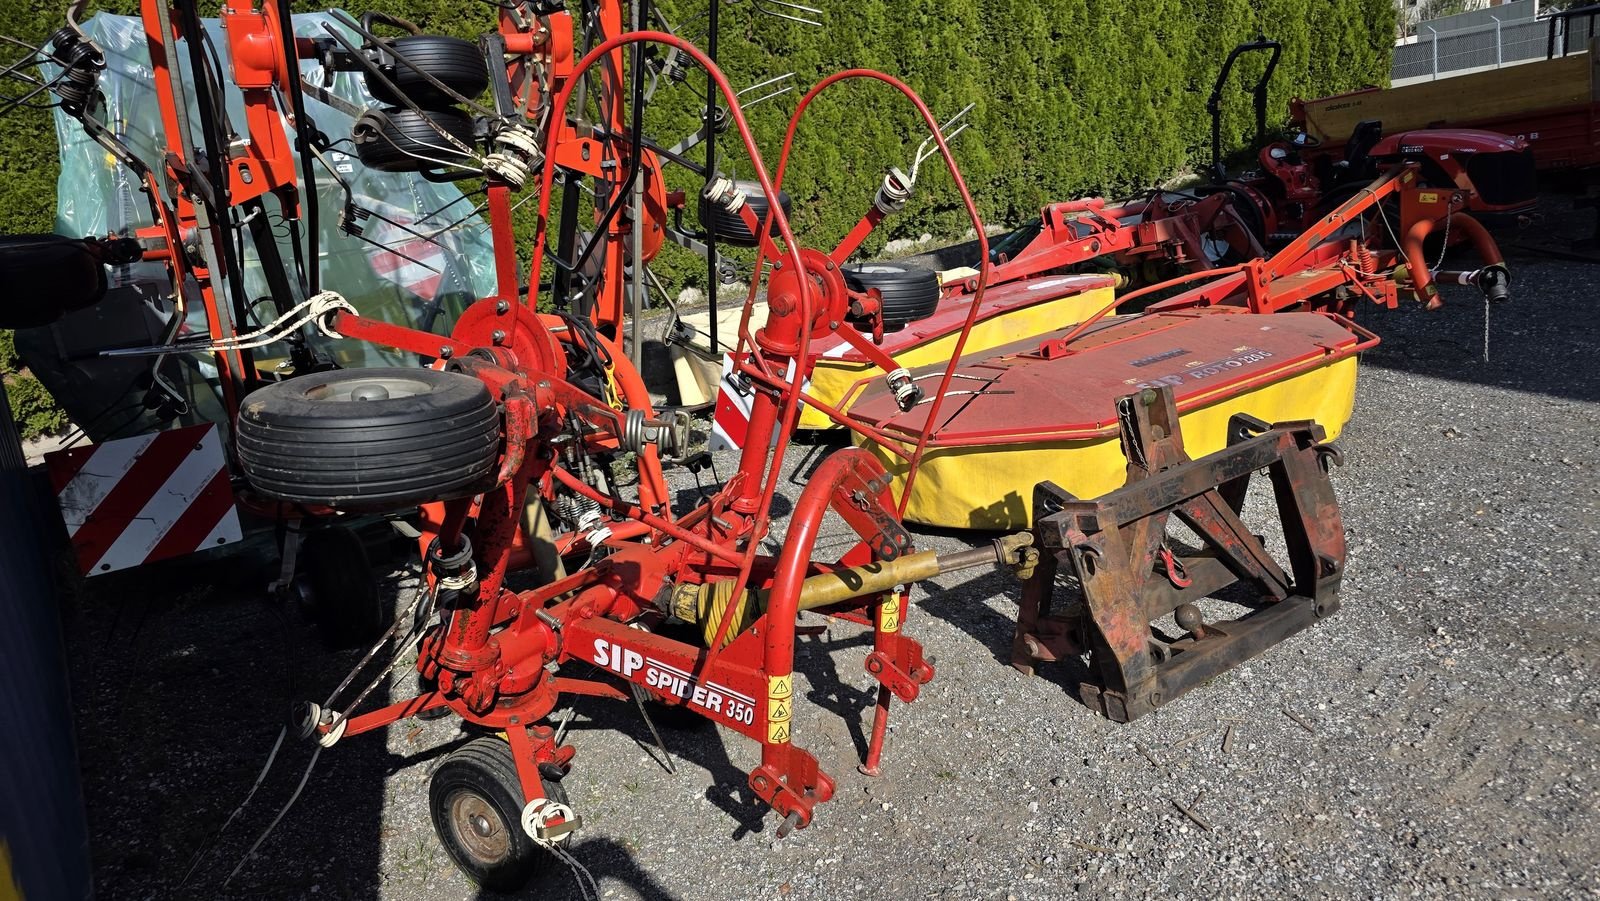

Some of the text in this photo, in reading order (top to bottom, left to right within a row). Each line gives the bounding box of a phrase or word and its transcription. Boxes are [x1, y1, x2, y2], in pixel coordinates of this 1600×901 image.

[1530, 132, 1539, 140] B
[1190, 360, 1242, 379] ROTO
[593, 639, 754, 725] SIP SPIDER 350
